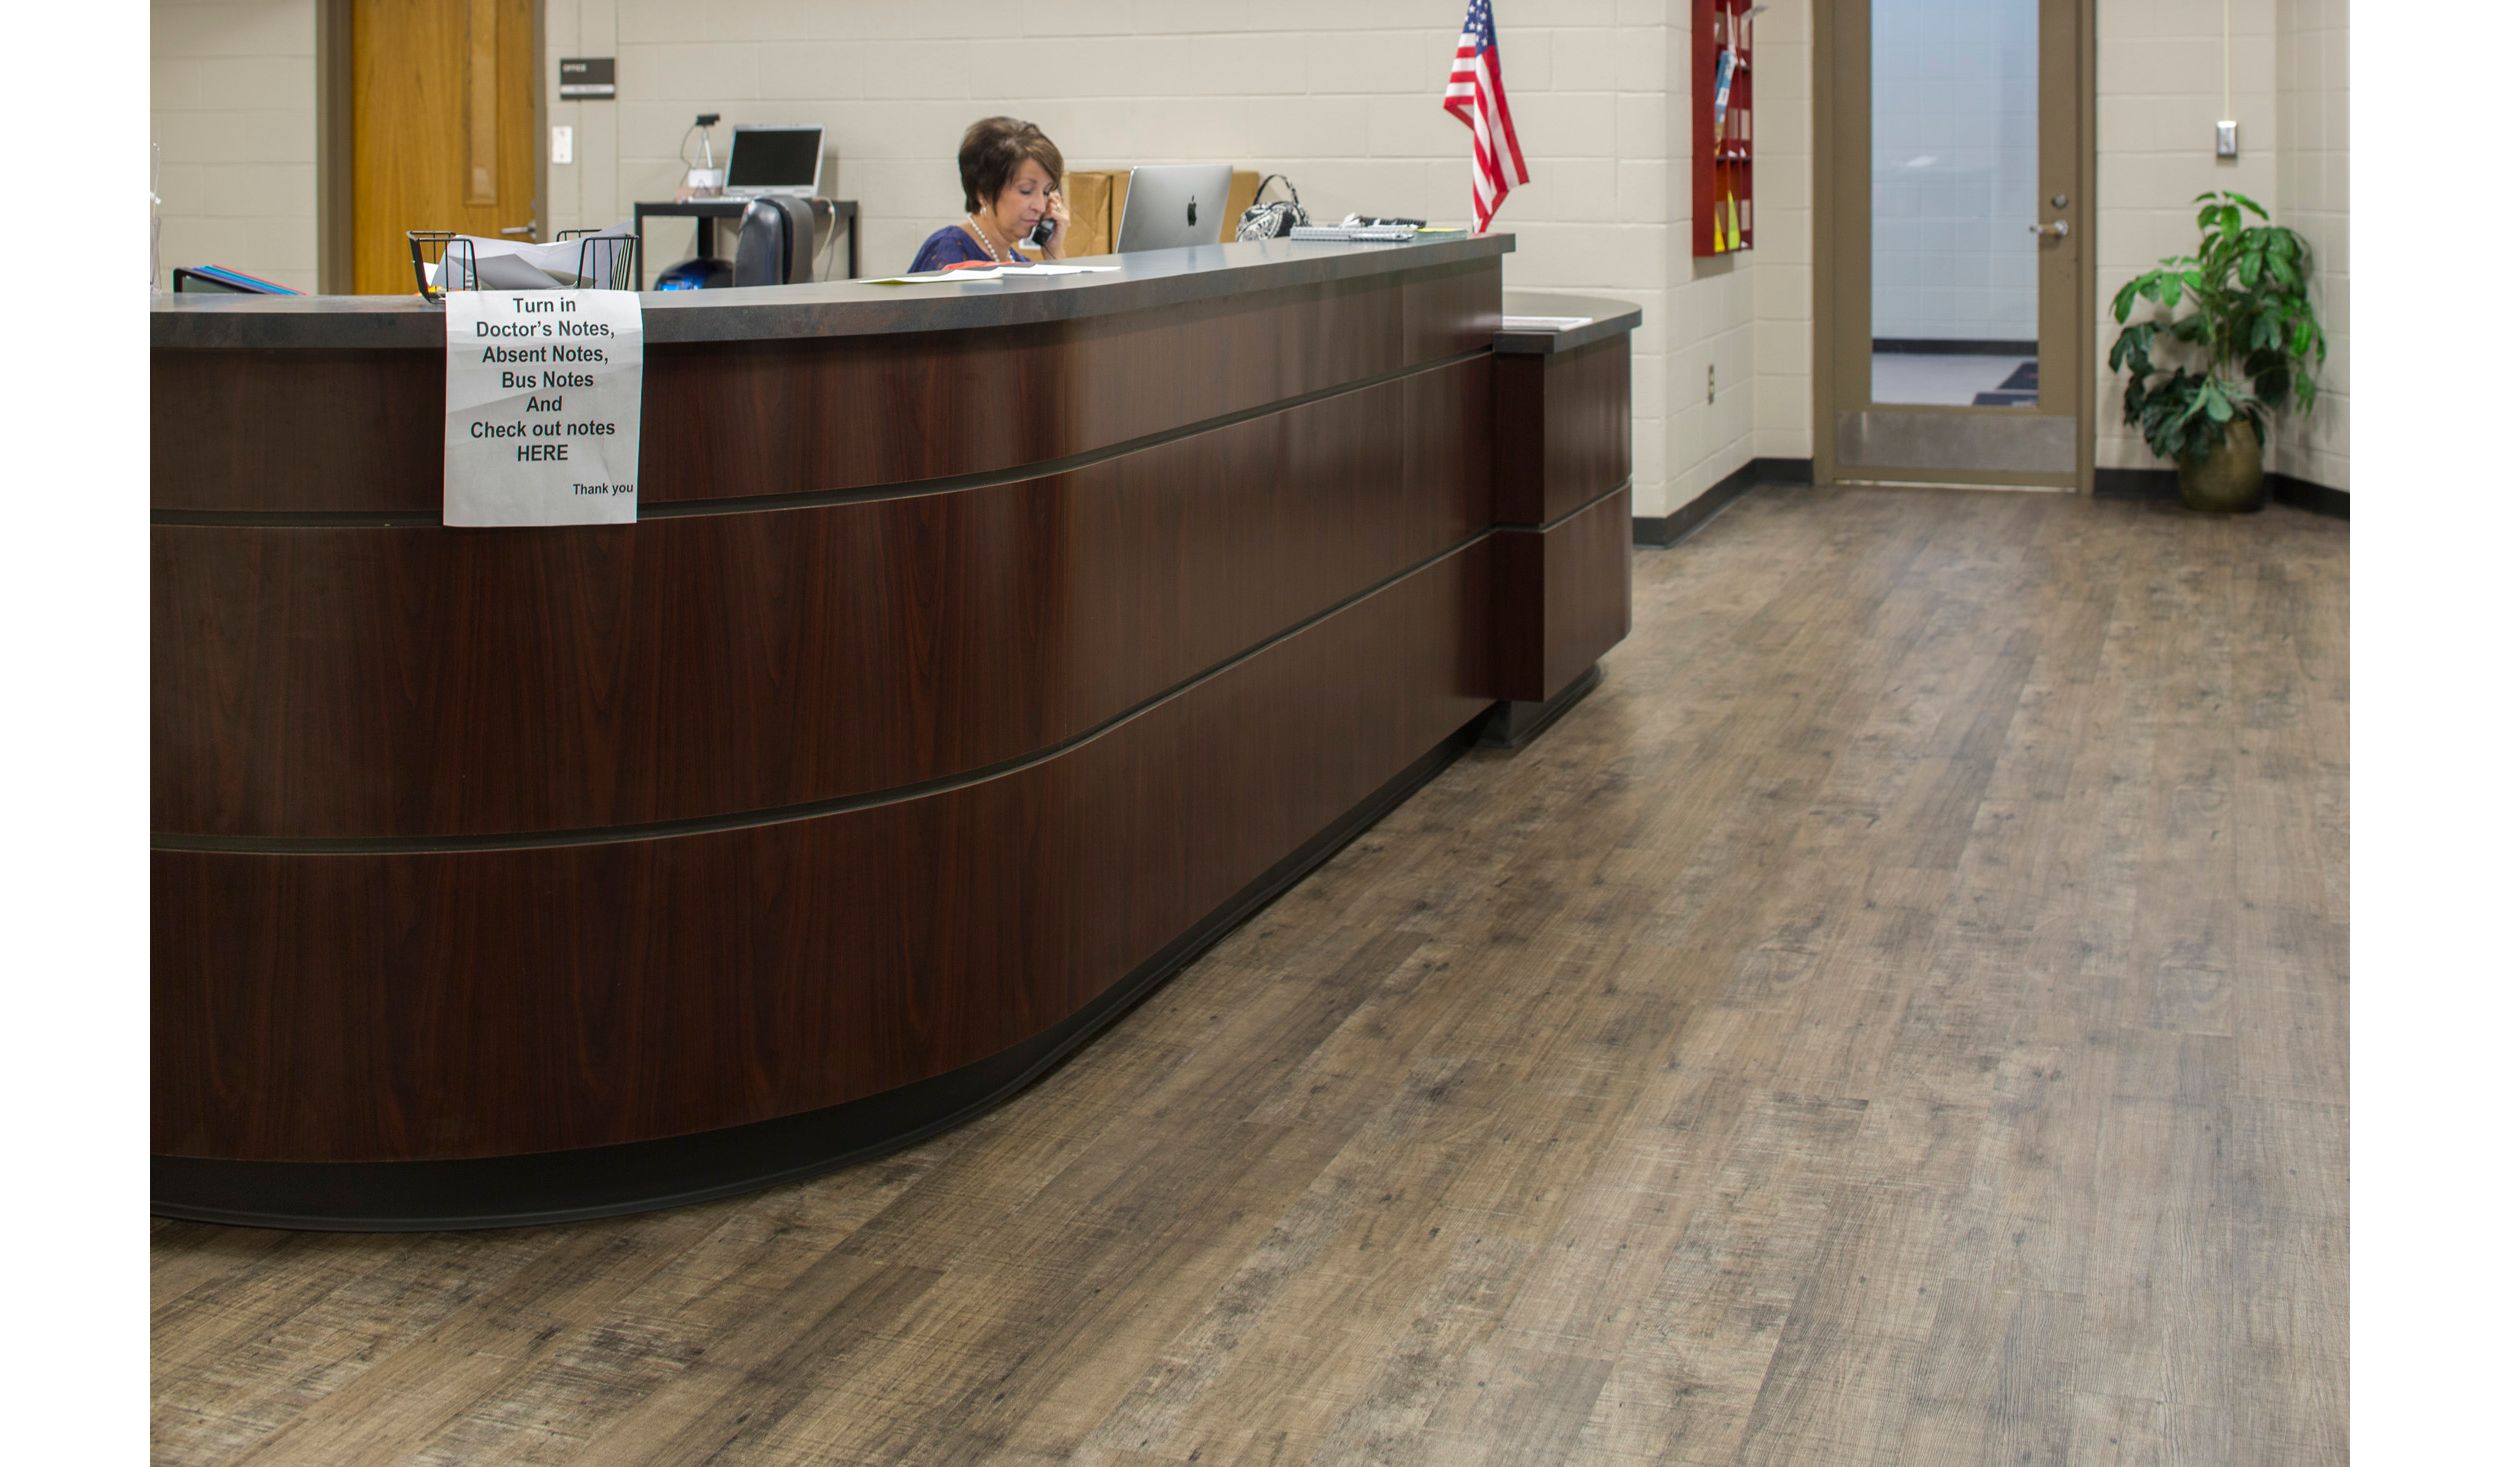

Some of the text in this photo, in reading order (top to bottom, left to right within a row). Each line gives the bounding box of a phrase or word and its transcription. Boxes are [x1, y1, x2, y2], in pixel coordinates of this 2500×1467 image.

[513, 297, 576, 313] Turn in
[476, 320, 615, 339] Doctor’s Notes,
[482, 345, 608, 365] Absent Notes,
[502, 371, 594, 388] Bus Notes
[526, 396, 562, 412] And
[471, 420, 615, 438] Check out notes
[517, 444, 568, 461] HERE
[573, 483, 633, 496] Thank you
